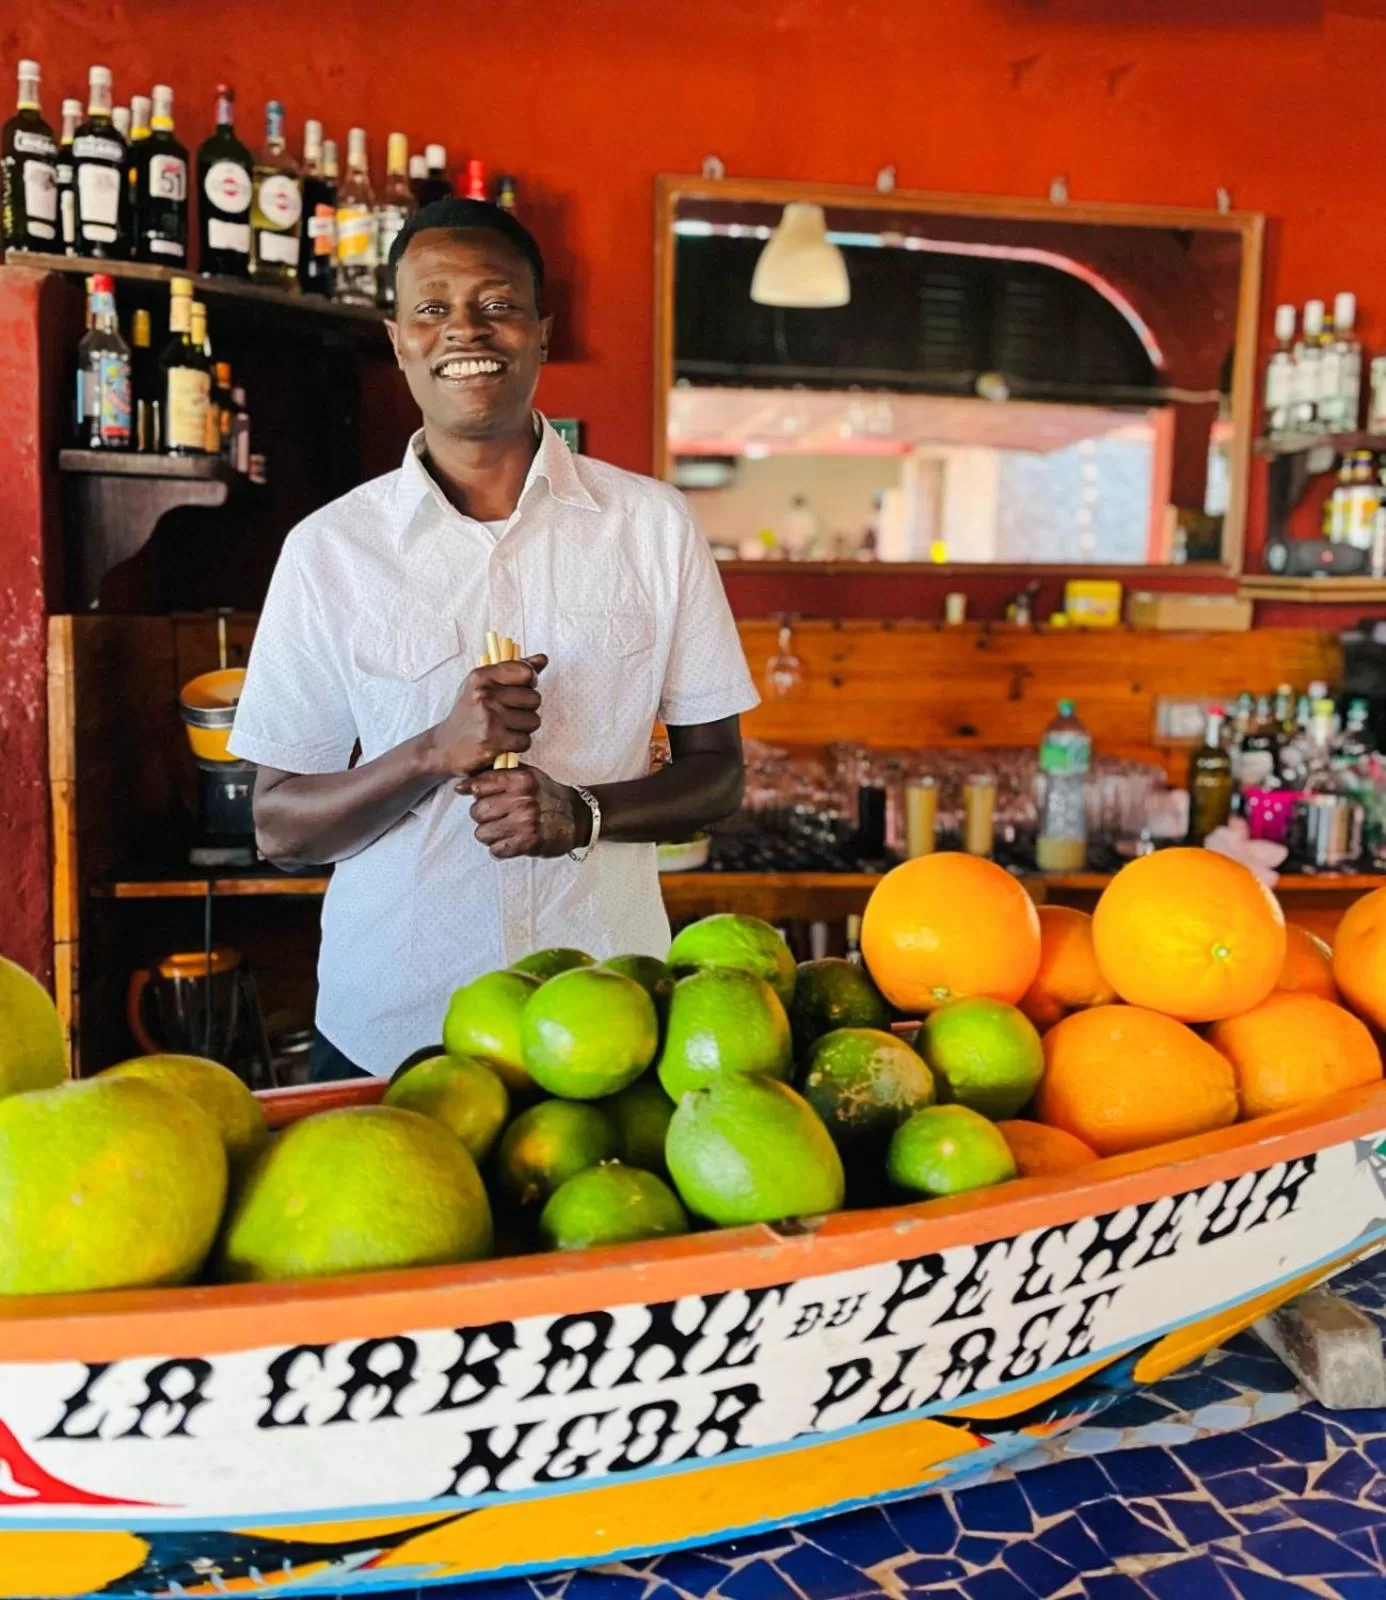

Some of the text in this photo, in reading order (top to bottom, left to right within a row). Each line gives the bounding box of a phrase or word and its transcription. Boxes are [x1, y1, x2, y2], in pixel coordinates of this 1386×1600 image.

[160, 168, 182, 197] 51
[38, 1153, 1318, 1439] LA CABANE DU PECHEUR
[436, 1286, 1123, 1498] NGOR PLAGE
